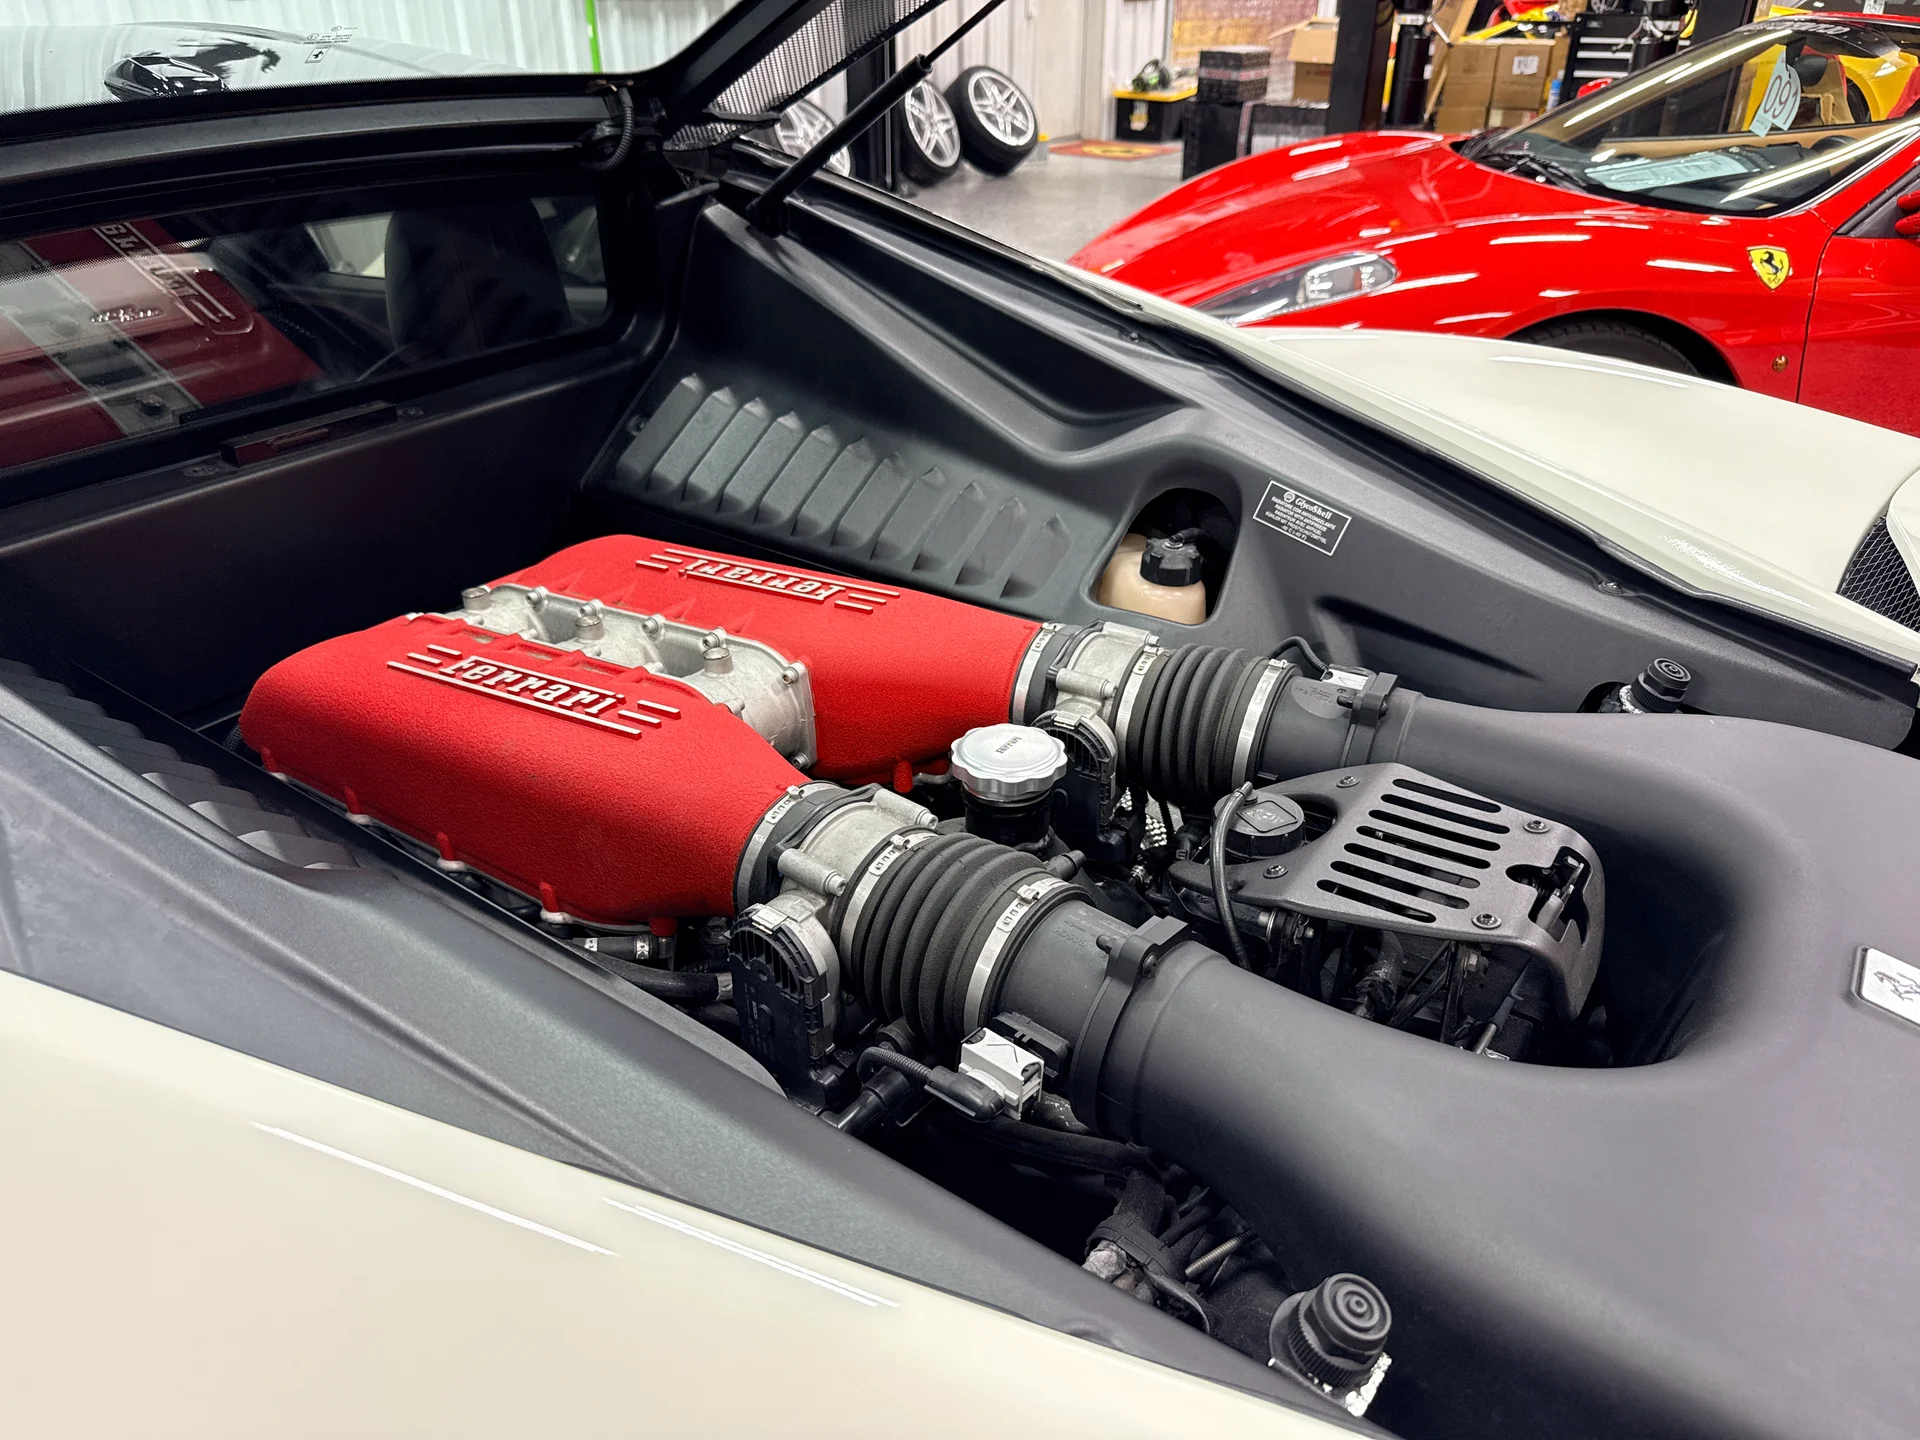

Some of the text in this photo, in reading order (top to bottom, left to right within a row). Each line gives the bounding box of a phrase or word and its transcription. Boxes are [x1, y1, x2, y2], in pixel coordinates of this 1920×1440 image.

[1271, 496, 1336, 530] RADIATORE CON ANTICONGELANTE
[1274, 504, 1294, 516] RADIATOR
[1303, 517, 1328, 532] ANTIFREEZE
[1295, 498, 1332, 519] GlycoShell
[678, 559, 846, 601] Ferrari
[438, 655, 626, 715] Ferrari
[995, 736, 1023, 755] Ferrari
[1053, 926, 1088, 948] BOSCH
